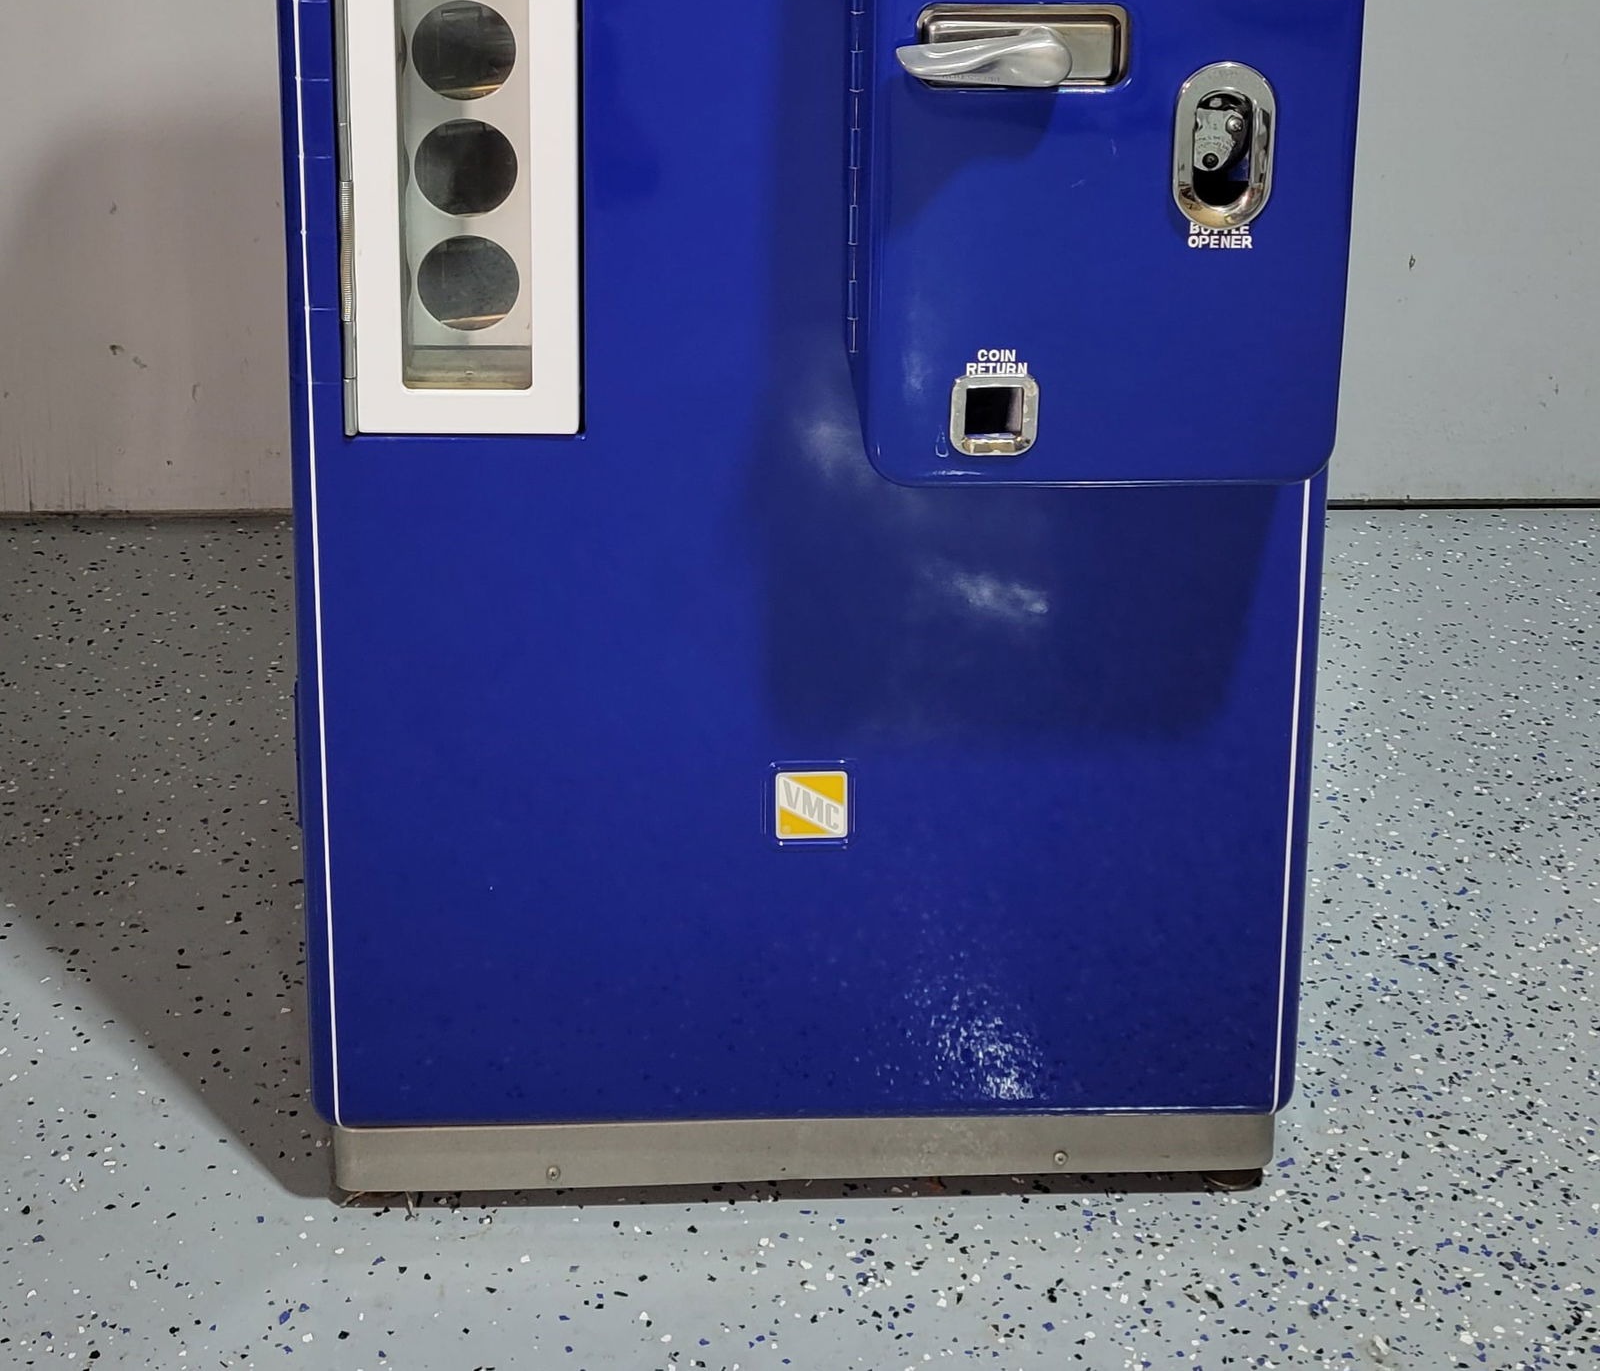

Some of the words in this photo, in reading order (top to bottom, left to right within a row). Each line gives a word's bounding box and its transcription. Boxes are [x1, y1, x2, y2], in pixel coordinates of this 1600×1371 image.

[1187, 235, 1253, 249] OPENER
[977, 349, 1016, 362] COIN
[966, 362, 1028, 376] RETURN
[783, 779, 840, 830] VMC
